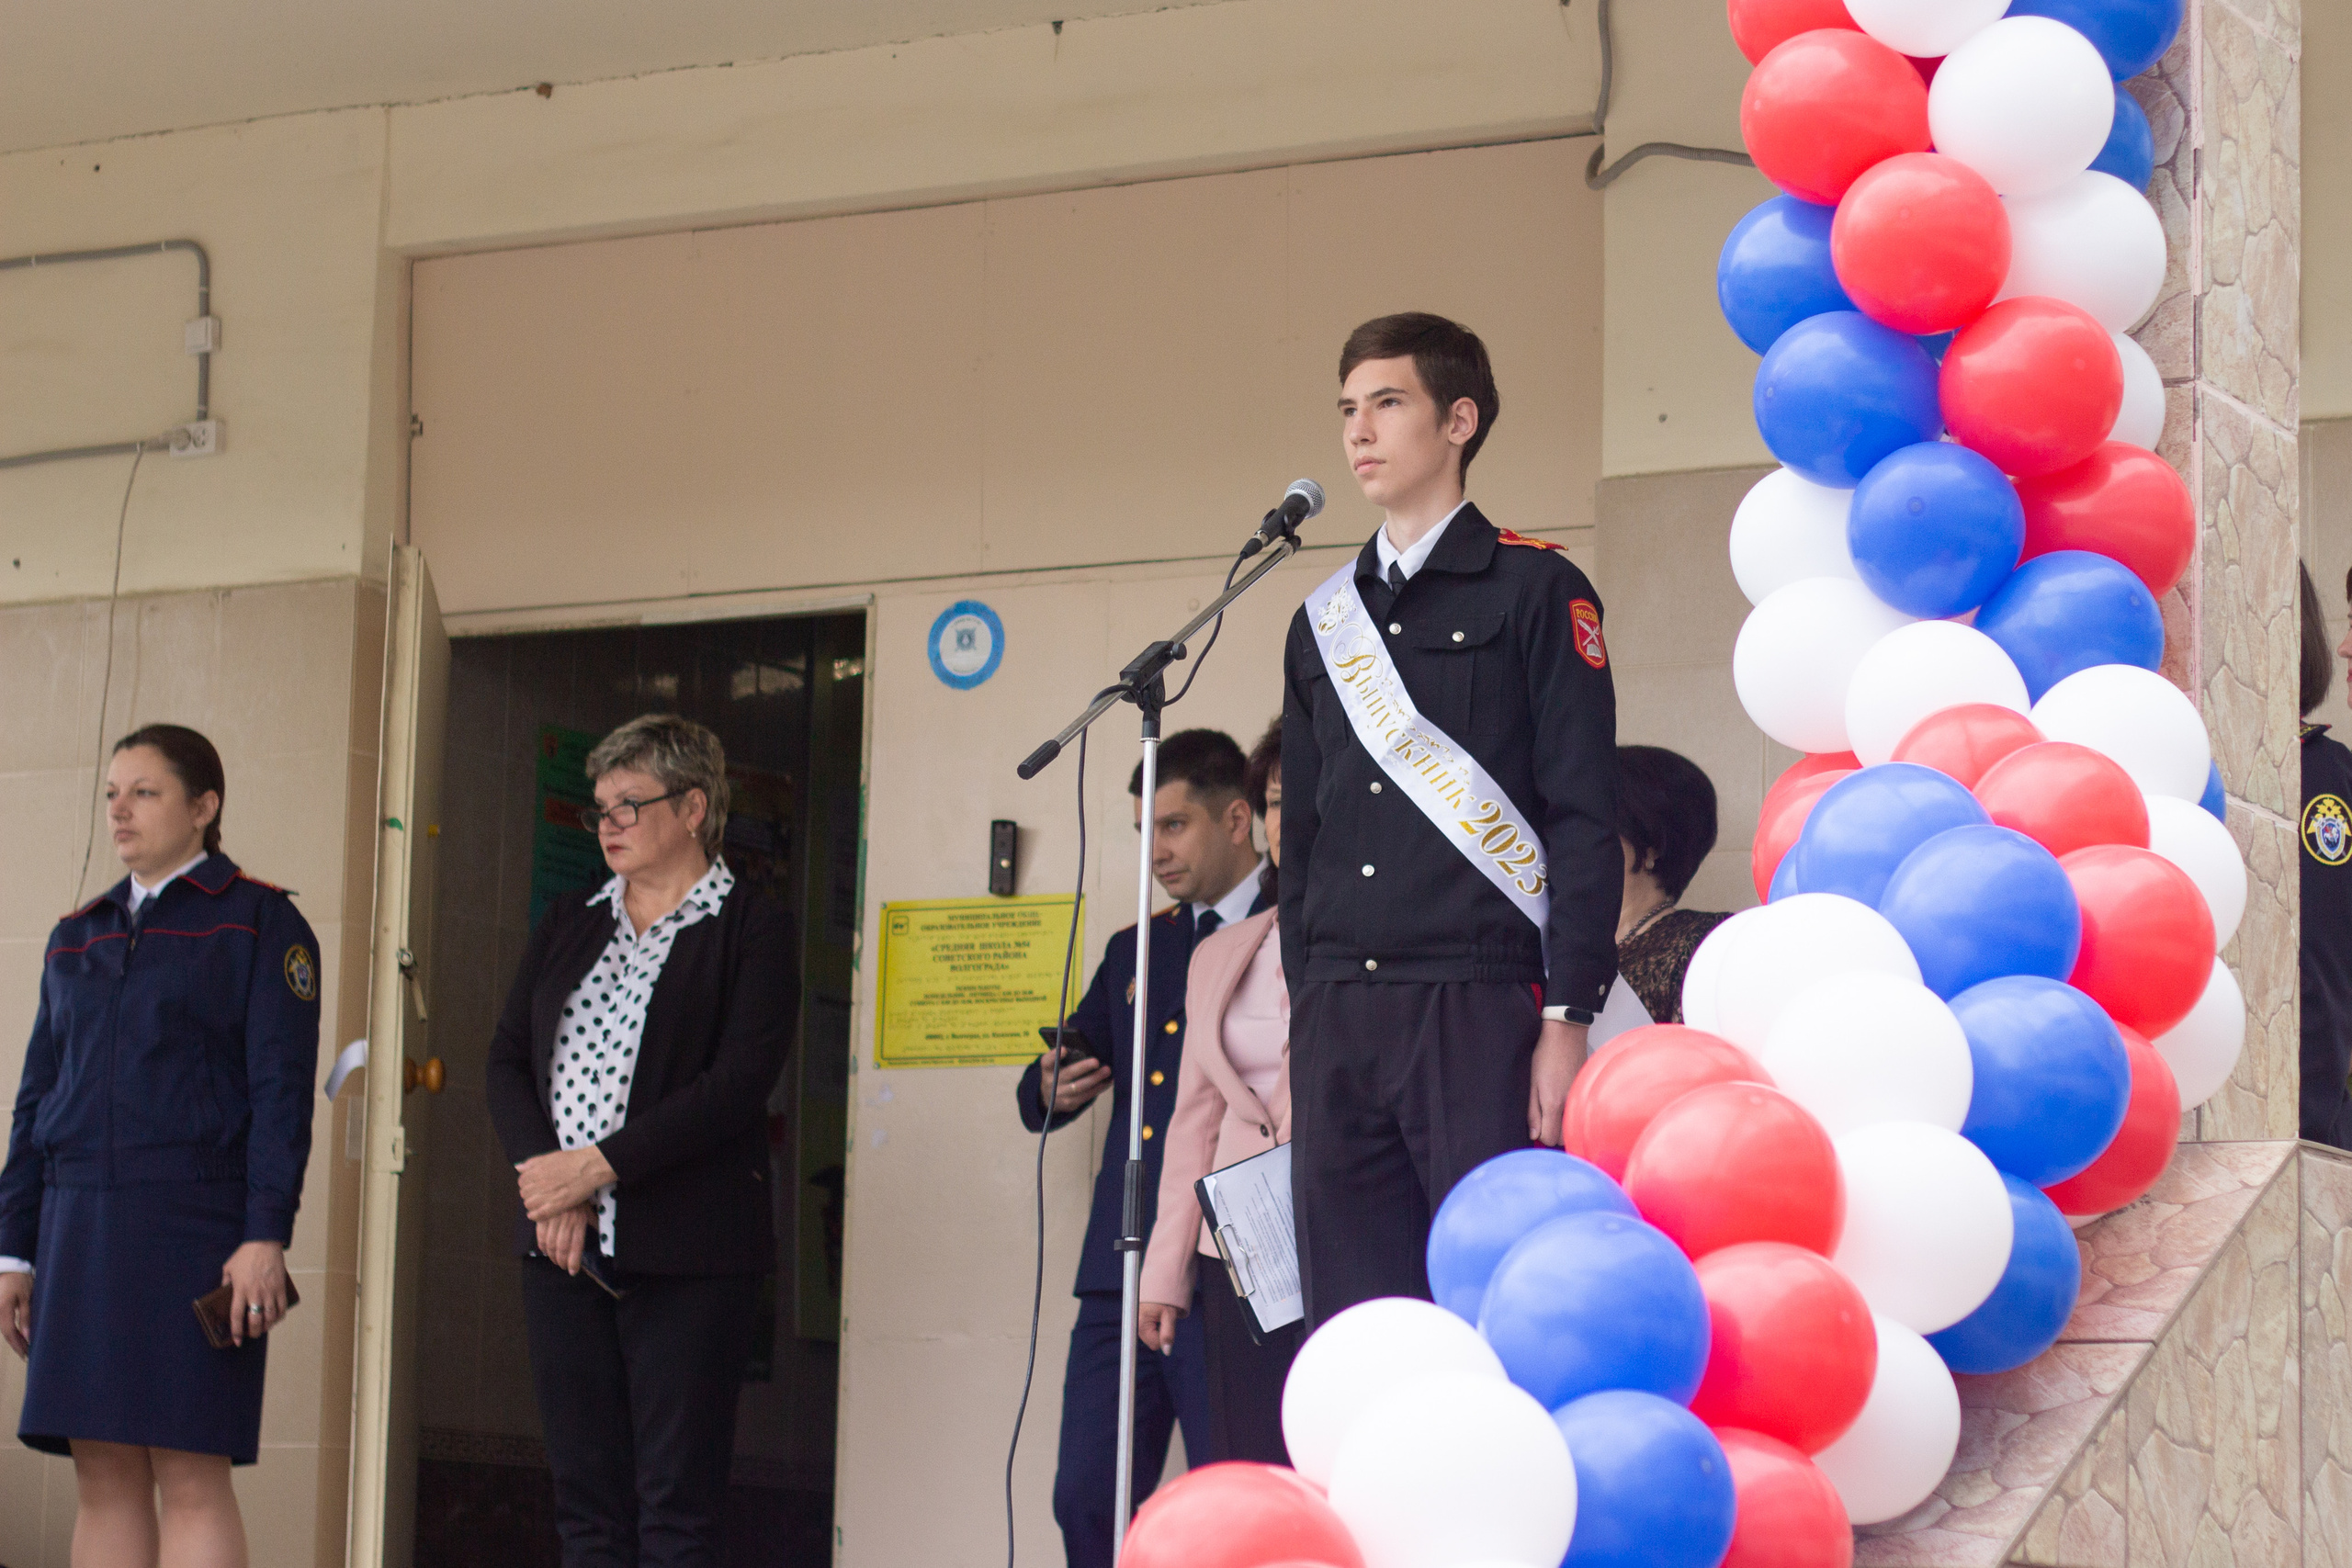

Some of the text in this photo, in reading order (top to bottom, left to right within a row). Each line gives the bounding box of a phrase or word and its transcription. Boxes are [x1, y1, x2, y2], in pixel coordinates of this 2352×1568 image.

[1330, 621, 1549, 897] Выпускник 2023
[978, 942, 1011, 950] ШКОЛА
[933, 951, 1027, 963] СОВЕТСКОГО РАЙОНА
